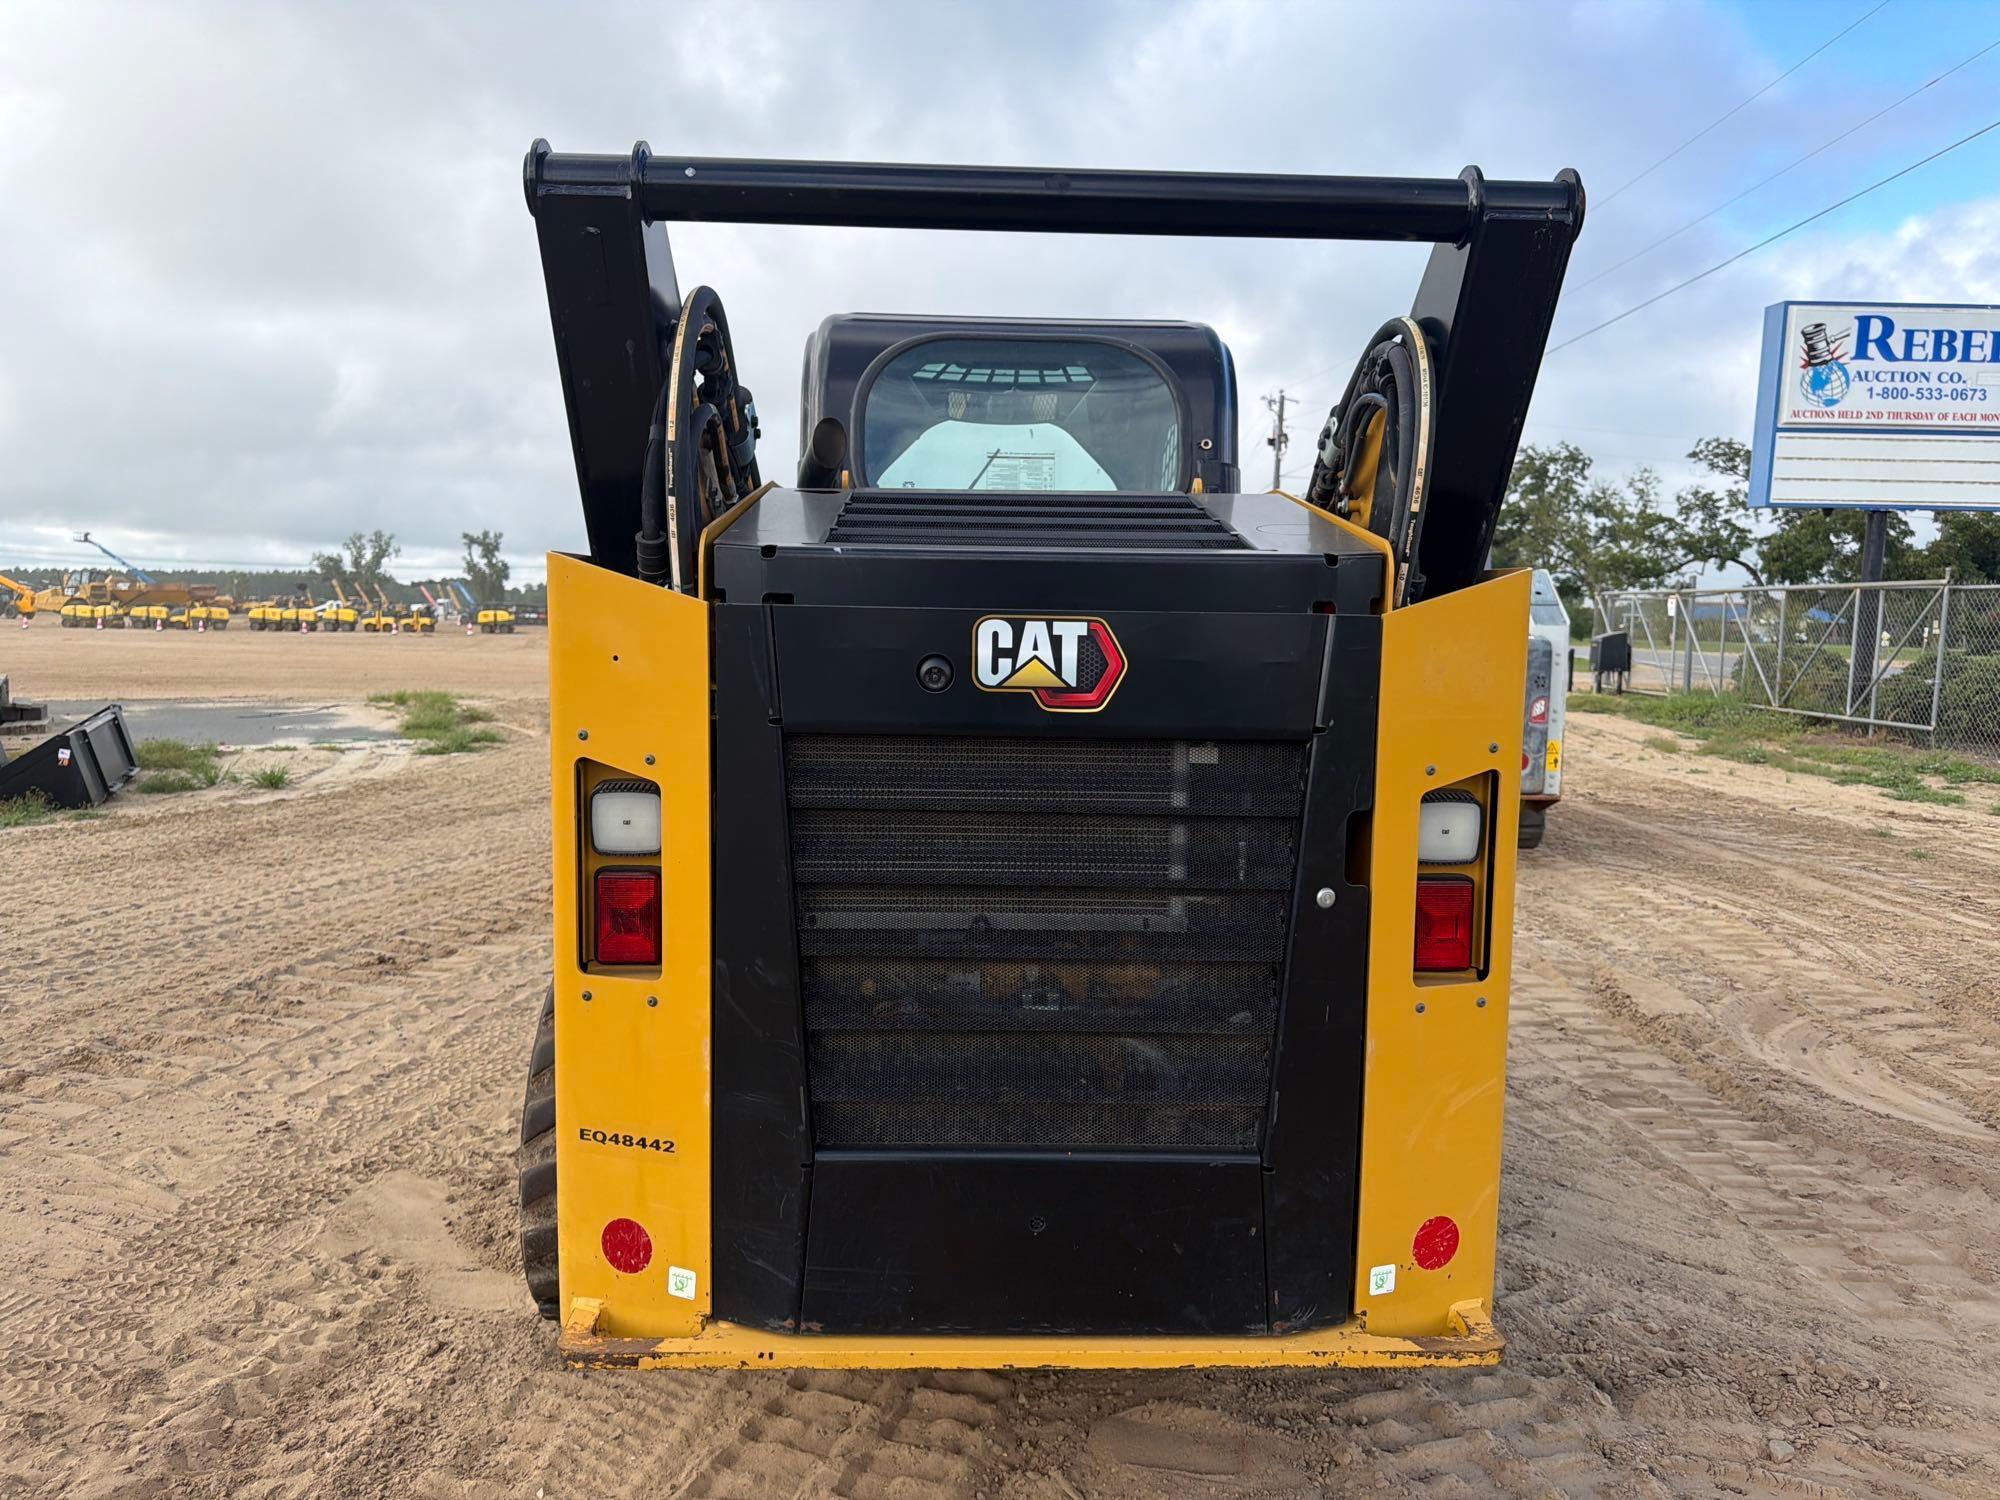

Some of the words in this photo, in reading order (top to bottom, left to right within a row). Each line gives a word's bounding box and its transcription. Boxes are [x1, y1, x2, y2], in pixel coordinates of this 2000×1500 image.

[1851, 369, 1932, 383] AUCTION
[1937, 371, 1967, 384] CO.
[1867, 387, 1988, 402] 1-800-533-0673
[1791, 410, 1835, 419] AUCTIONS
[1837, 411, 1863, 420] HELD
[1866, 411, 1884, 420] 2ND
[1887, 411, 1934, 421] THURSDAY
[1937, 412, 1950, 421] OF
[1952, 412, 1977, 421] EACH
[977, 619, 1088, 688] CAT
[579, 1128, 676, 1153] EQ48442
